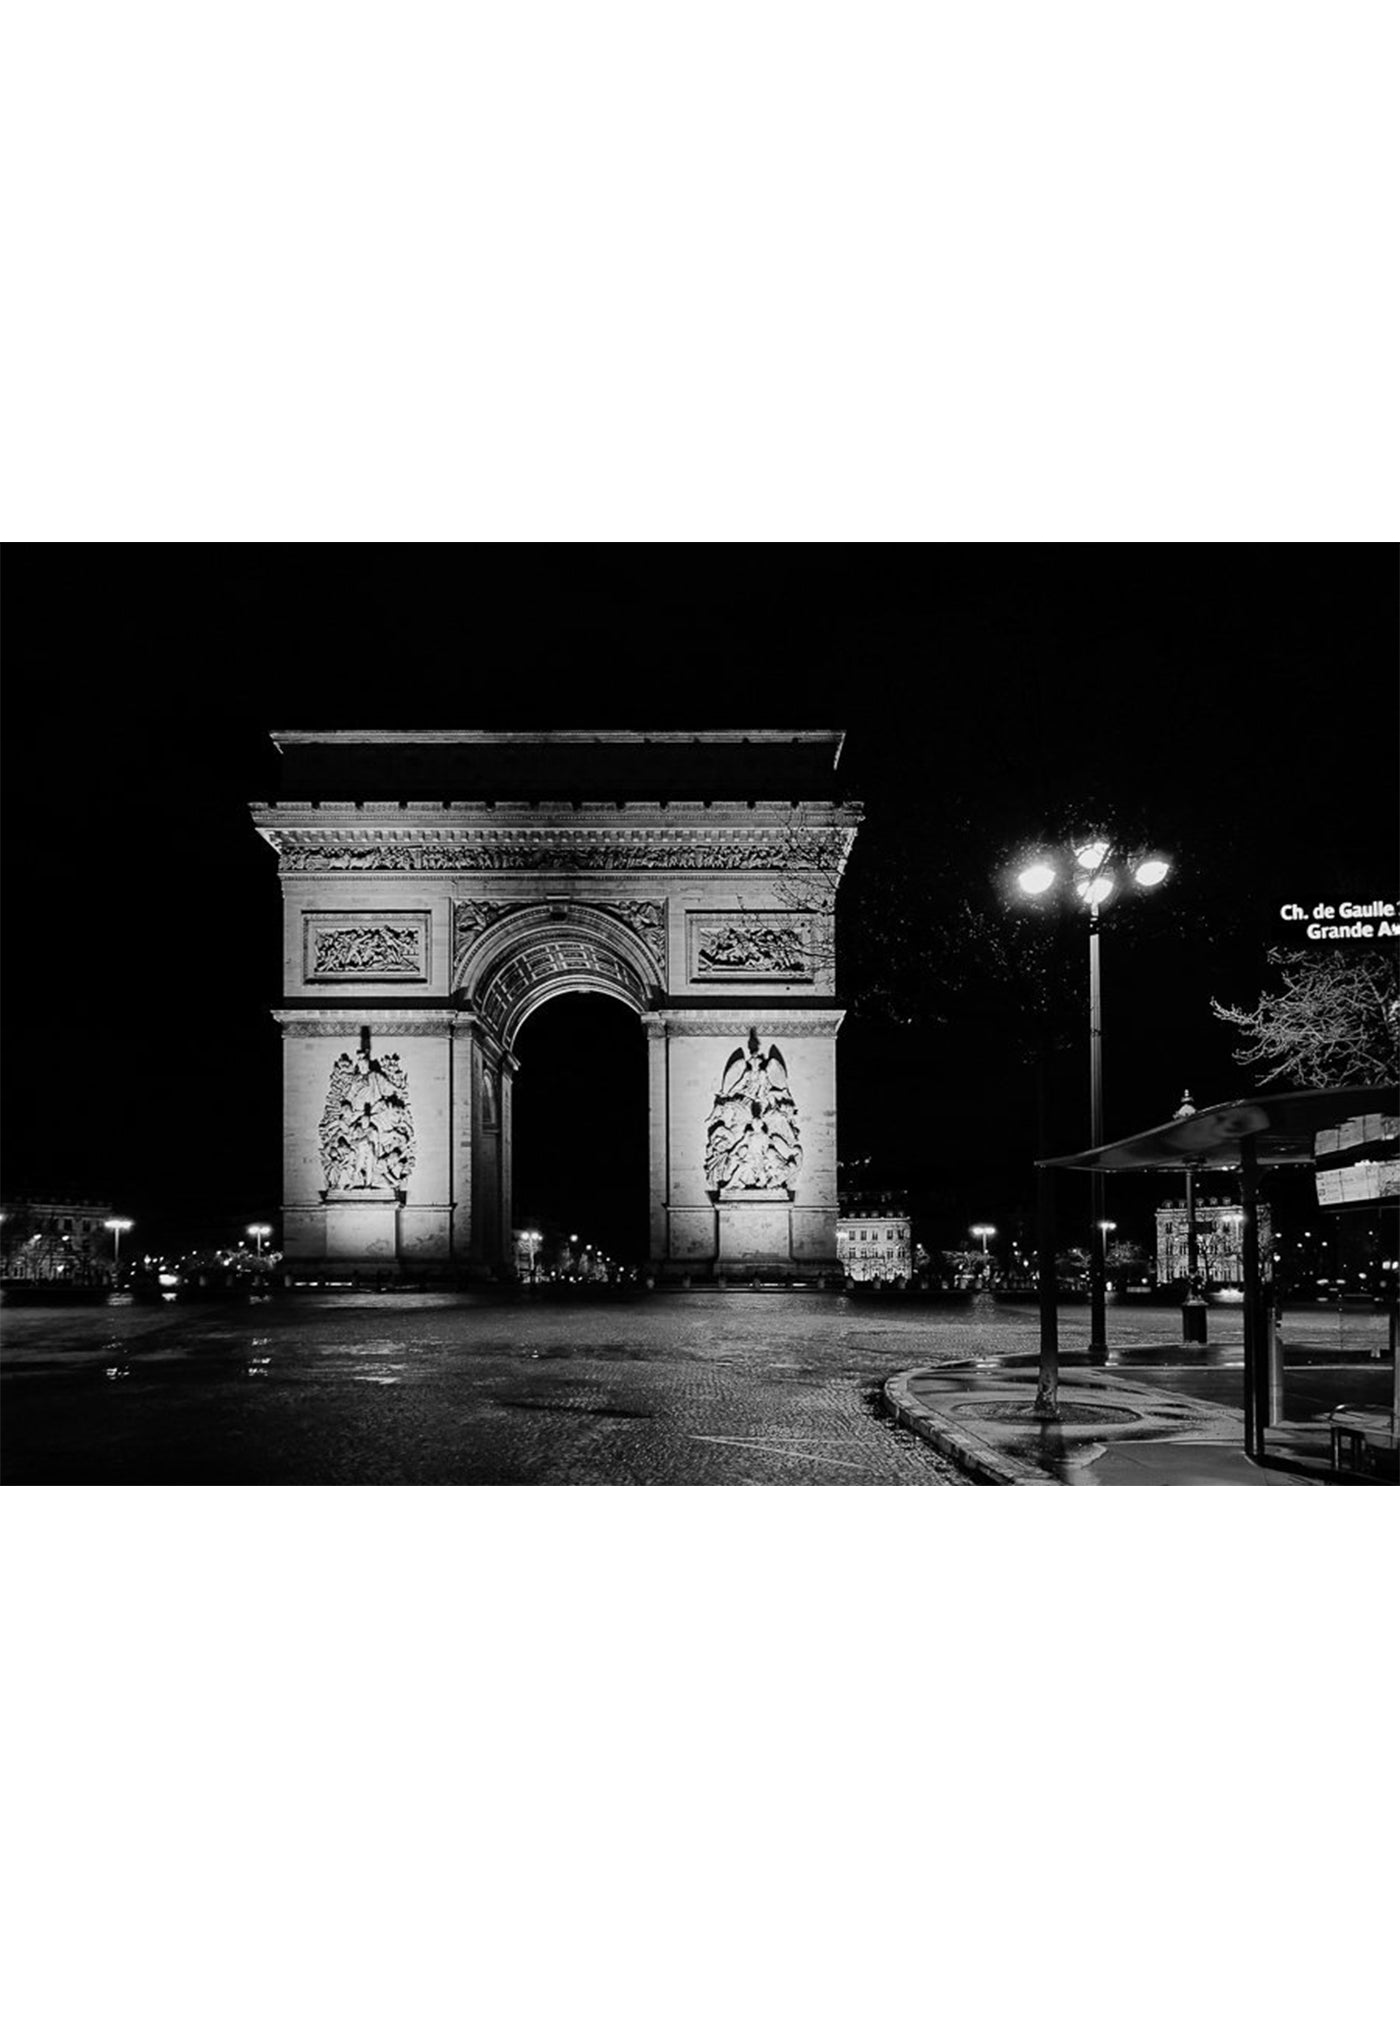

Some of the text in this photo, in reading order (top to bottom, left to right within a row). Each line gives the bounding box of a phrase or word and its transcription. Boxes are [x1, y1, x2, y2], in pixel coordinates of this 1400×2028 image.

[1280, 904, 1309, 920] Ch.
[1312, 903, 1335, 919] de
[1339, 900, 1395, 919] Gaulle
[1307, 921, 1374, 940] Grande
